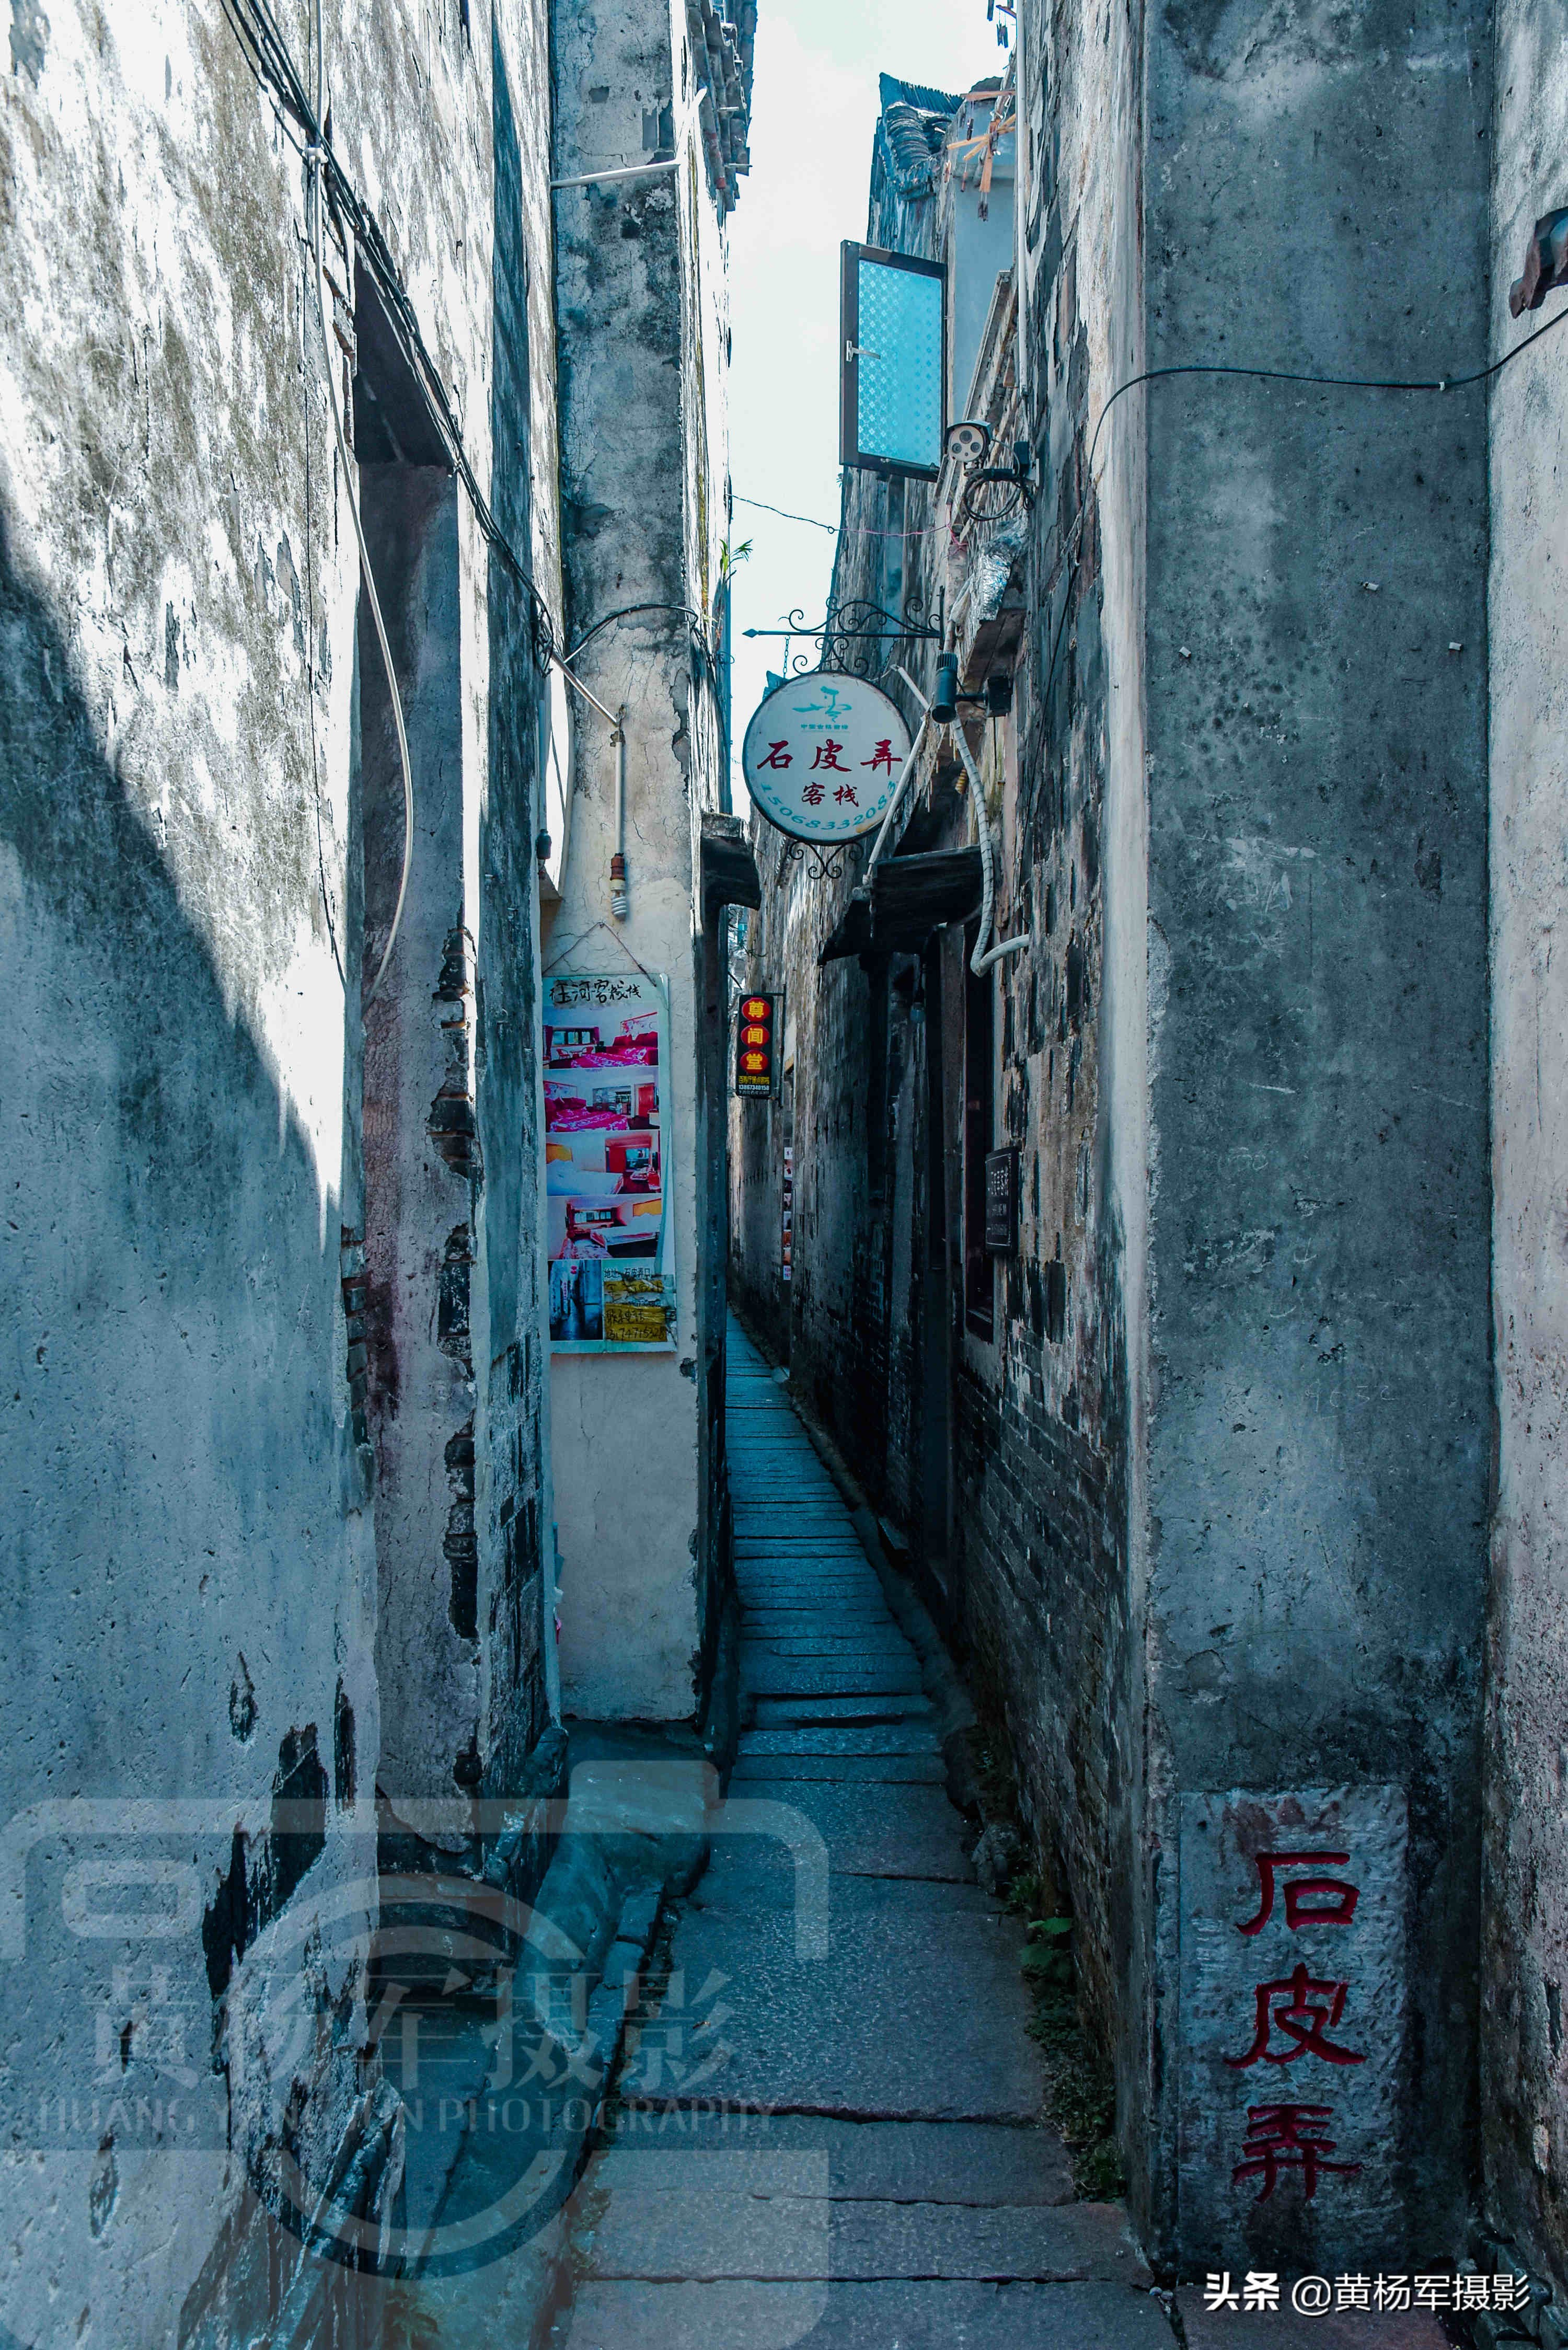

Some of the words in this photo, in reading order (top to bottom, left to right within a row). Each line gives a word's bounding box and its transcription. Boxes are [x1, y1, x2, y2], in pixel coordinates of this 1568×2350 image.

[756, 738, 903, 776] 石皮弄
[801, 781, 859, 807] 客栈
[746, 1001, 765, 1070] 尊闻堂
[1223, 1851, 1368, 2203] 石皮弄
